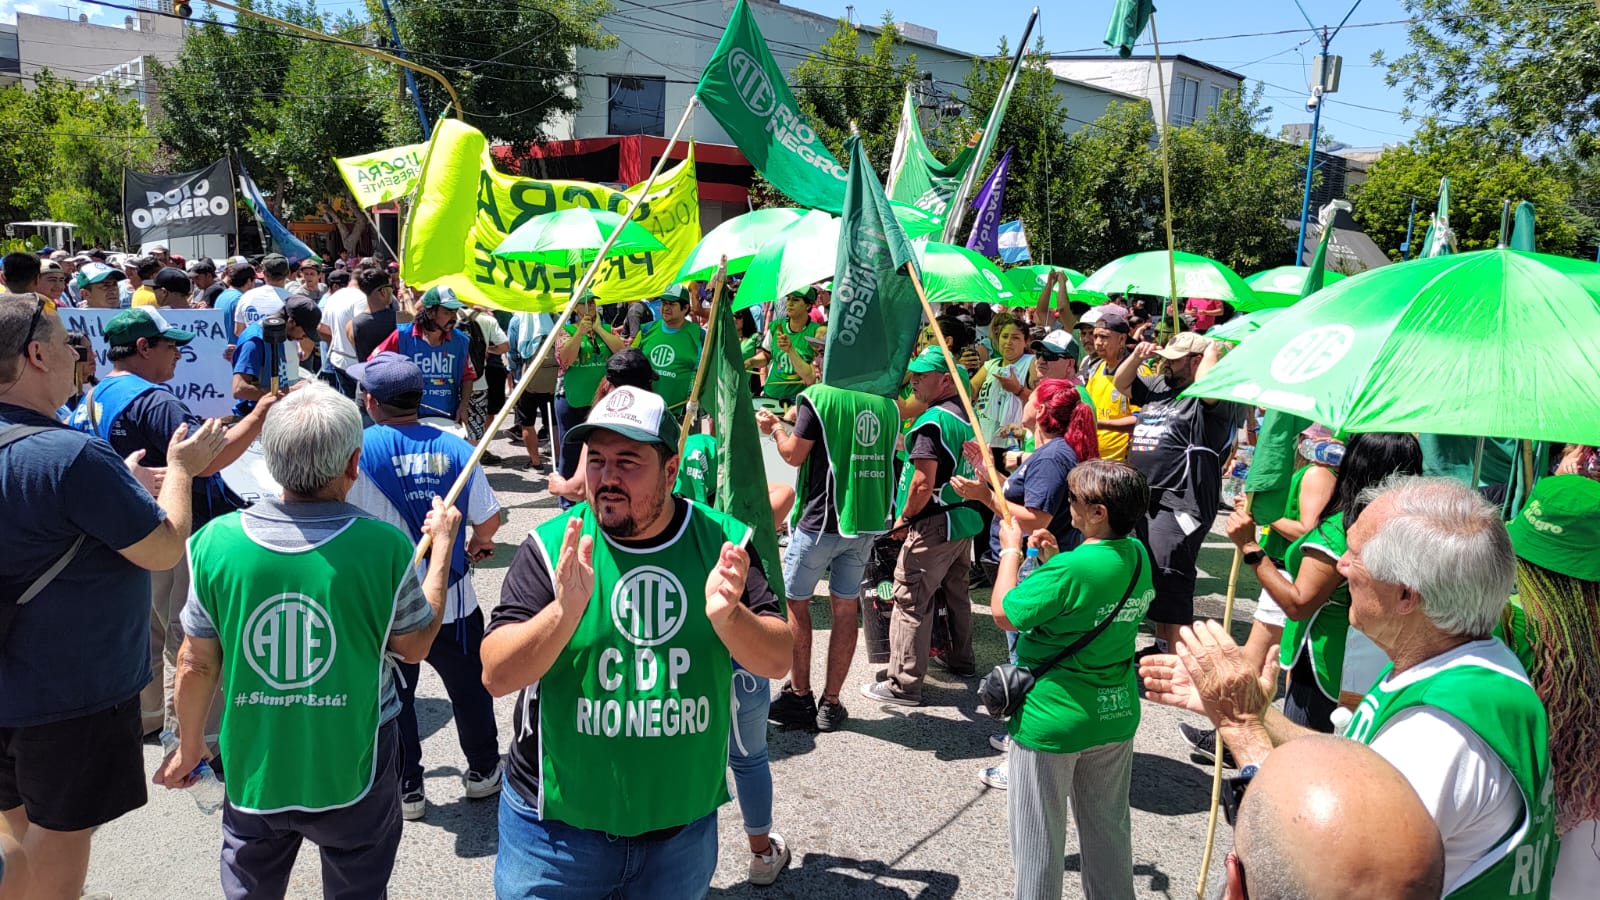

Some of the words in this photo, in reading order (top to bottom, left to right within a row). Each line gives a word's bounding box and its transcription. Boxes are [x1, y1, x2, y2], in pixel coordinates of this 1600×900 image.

[732, 54, 772, 112] ATE
[765, 115, 849, 181] NEGRO
[414, 351, 456, 374] FeNaT
[856, 416, 878, 441] ATE
[618, 573, 678, 640] ATE
[252, 601, 325, 681] ATE
[576, 697, 622, 737] RIO
[625, 696, 710, 738] NEGRO
